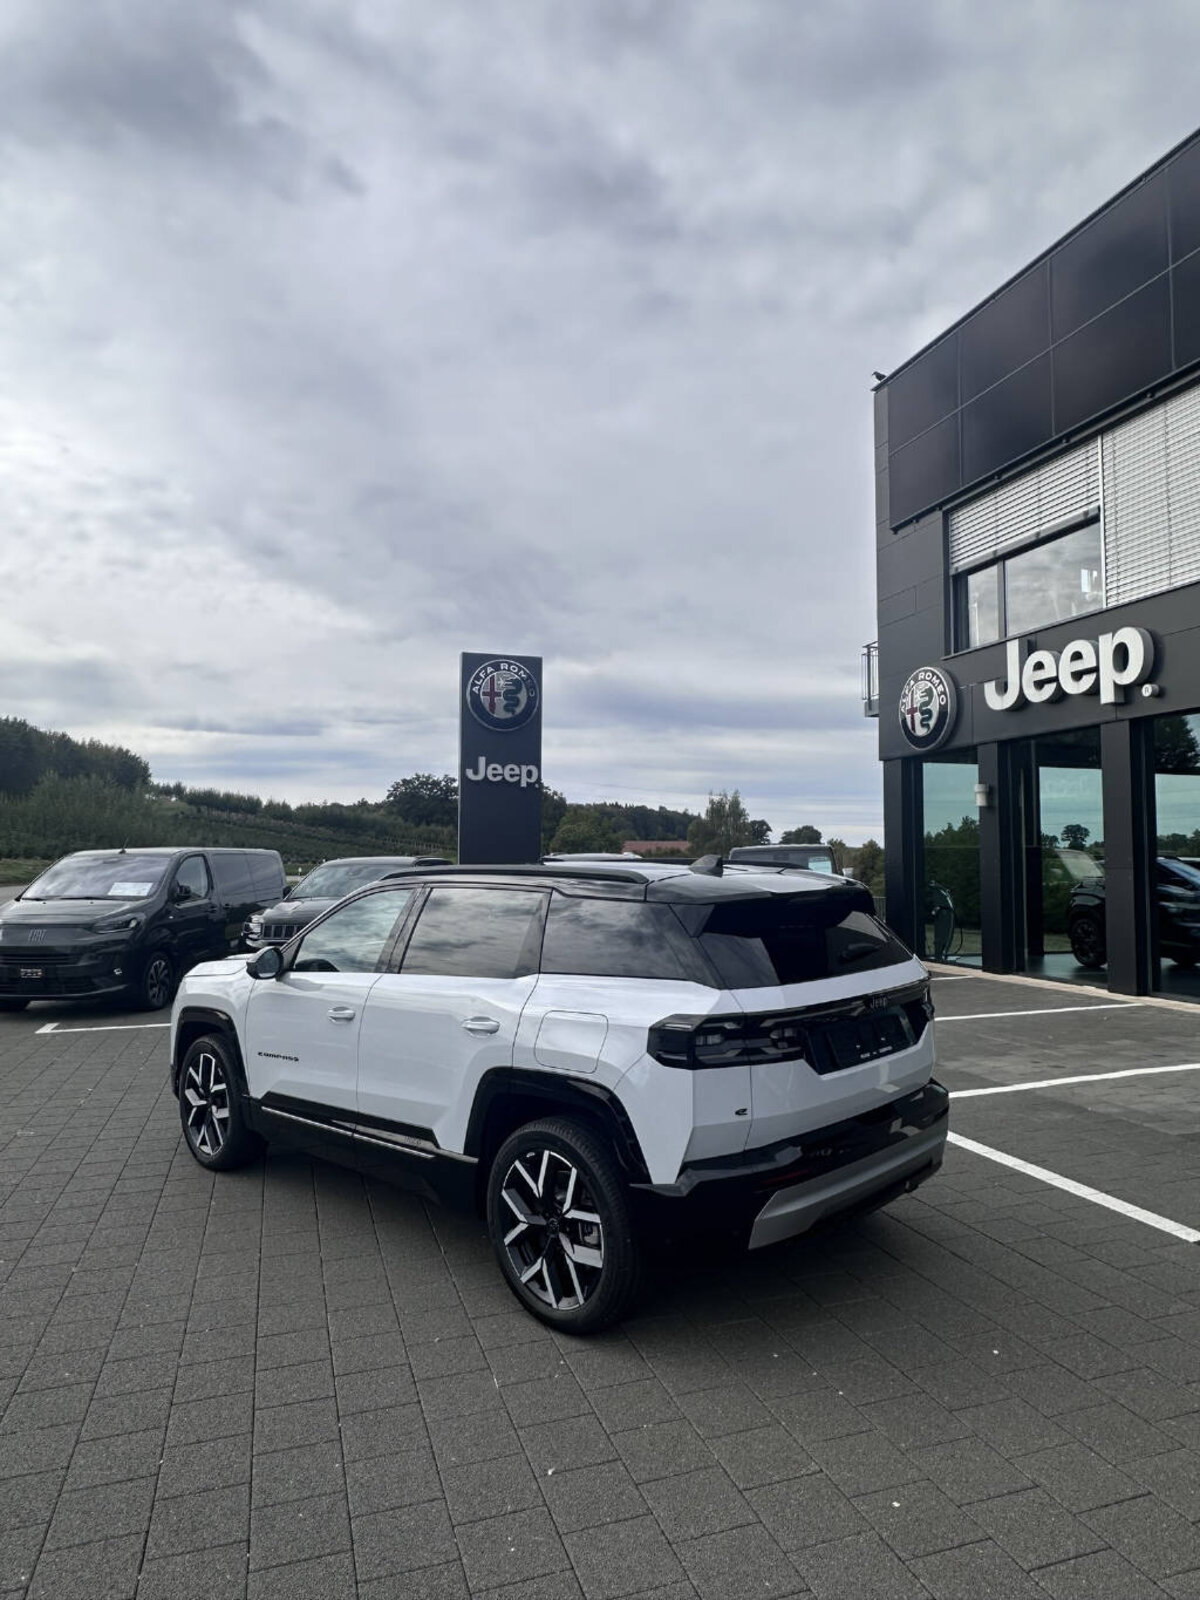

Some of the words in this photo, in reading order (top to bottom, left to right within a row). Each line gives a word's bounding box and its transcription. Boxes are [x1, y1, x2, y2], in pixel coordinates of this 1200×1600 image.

[471, 666, 496, 695] ALFA
[500, 662, 536, 697] ROMO
[918, 671, 947, 706] ROMEO
[465, 755, 540, 788] Jeep
